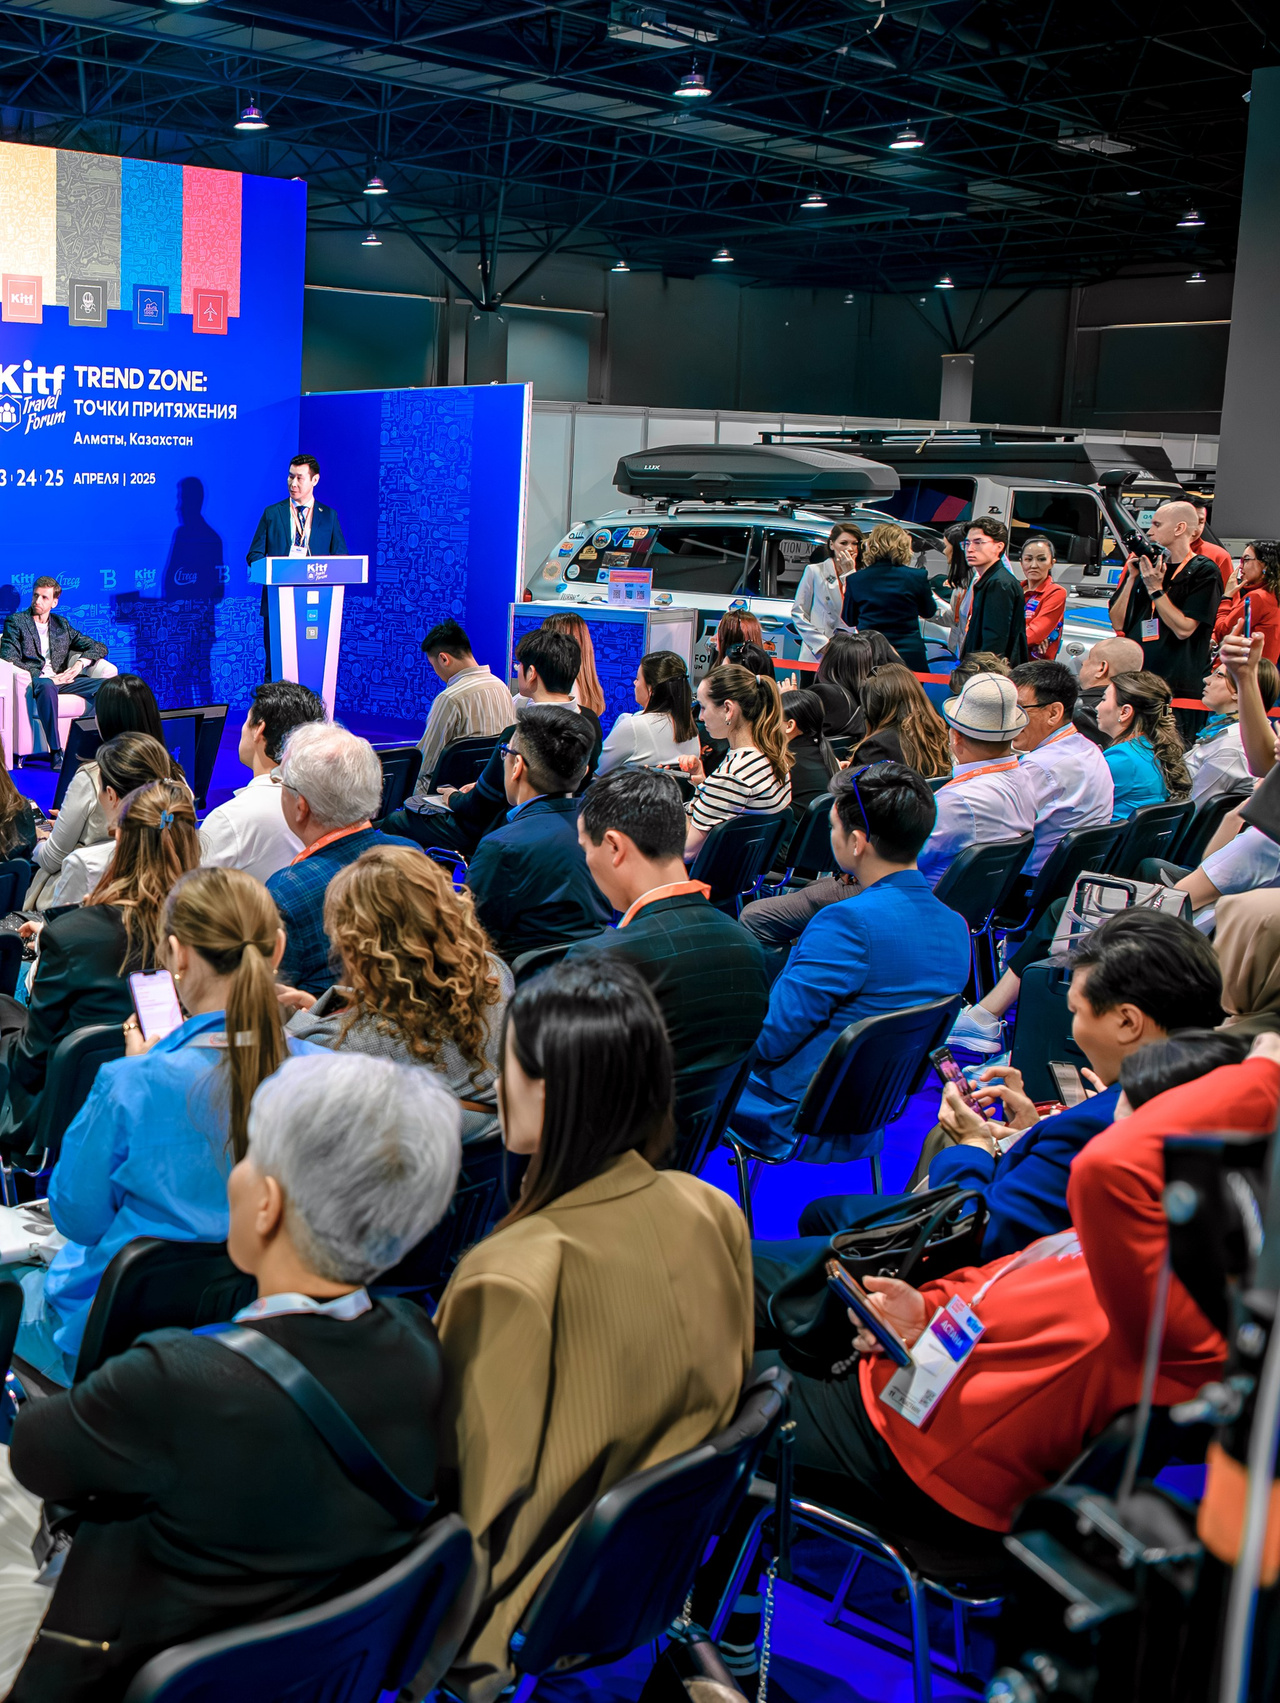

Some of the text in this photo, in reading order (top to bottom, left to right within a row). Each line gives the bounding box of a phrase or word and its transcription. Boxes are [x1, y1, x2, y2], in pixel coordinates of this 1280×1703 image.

[73, 365, 208, 392] TREND ZONE:
[22, 389, 62, 412] Travel
[73, 399, 238, 420] ТОЧКИ ПРИТЯЖЕНИЯ
[25, 410, 66, 435] Forum
[73, 431, 193, 446] Алматы, Казахстан
[73, 472, 120, 485] АПРЕЛЯ
[130, 472, 156, 485] 2025
[134, 567, 156, 579] Kitf
[307, 563, 328, 573] Kitf
[11, 572, 35, 584] Kitf
